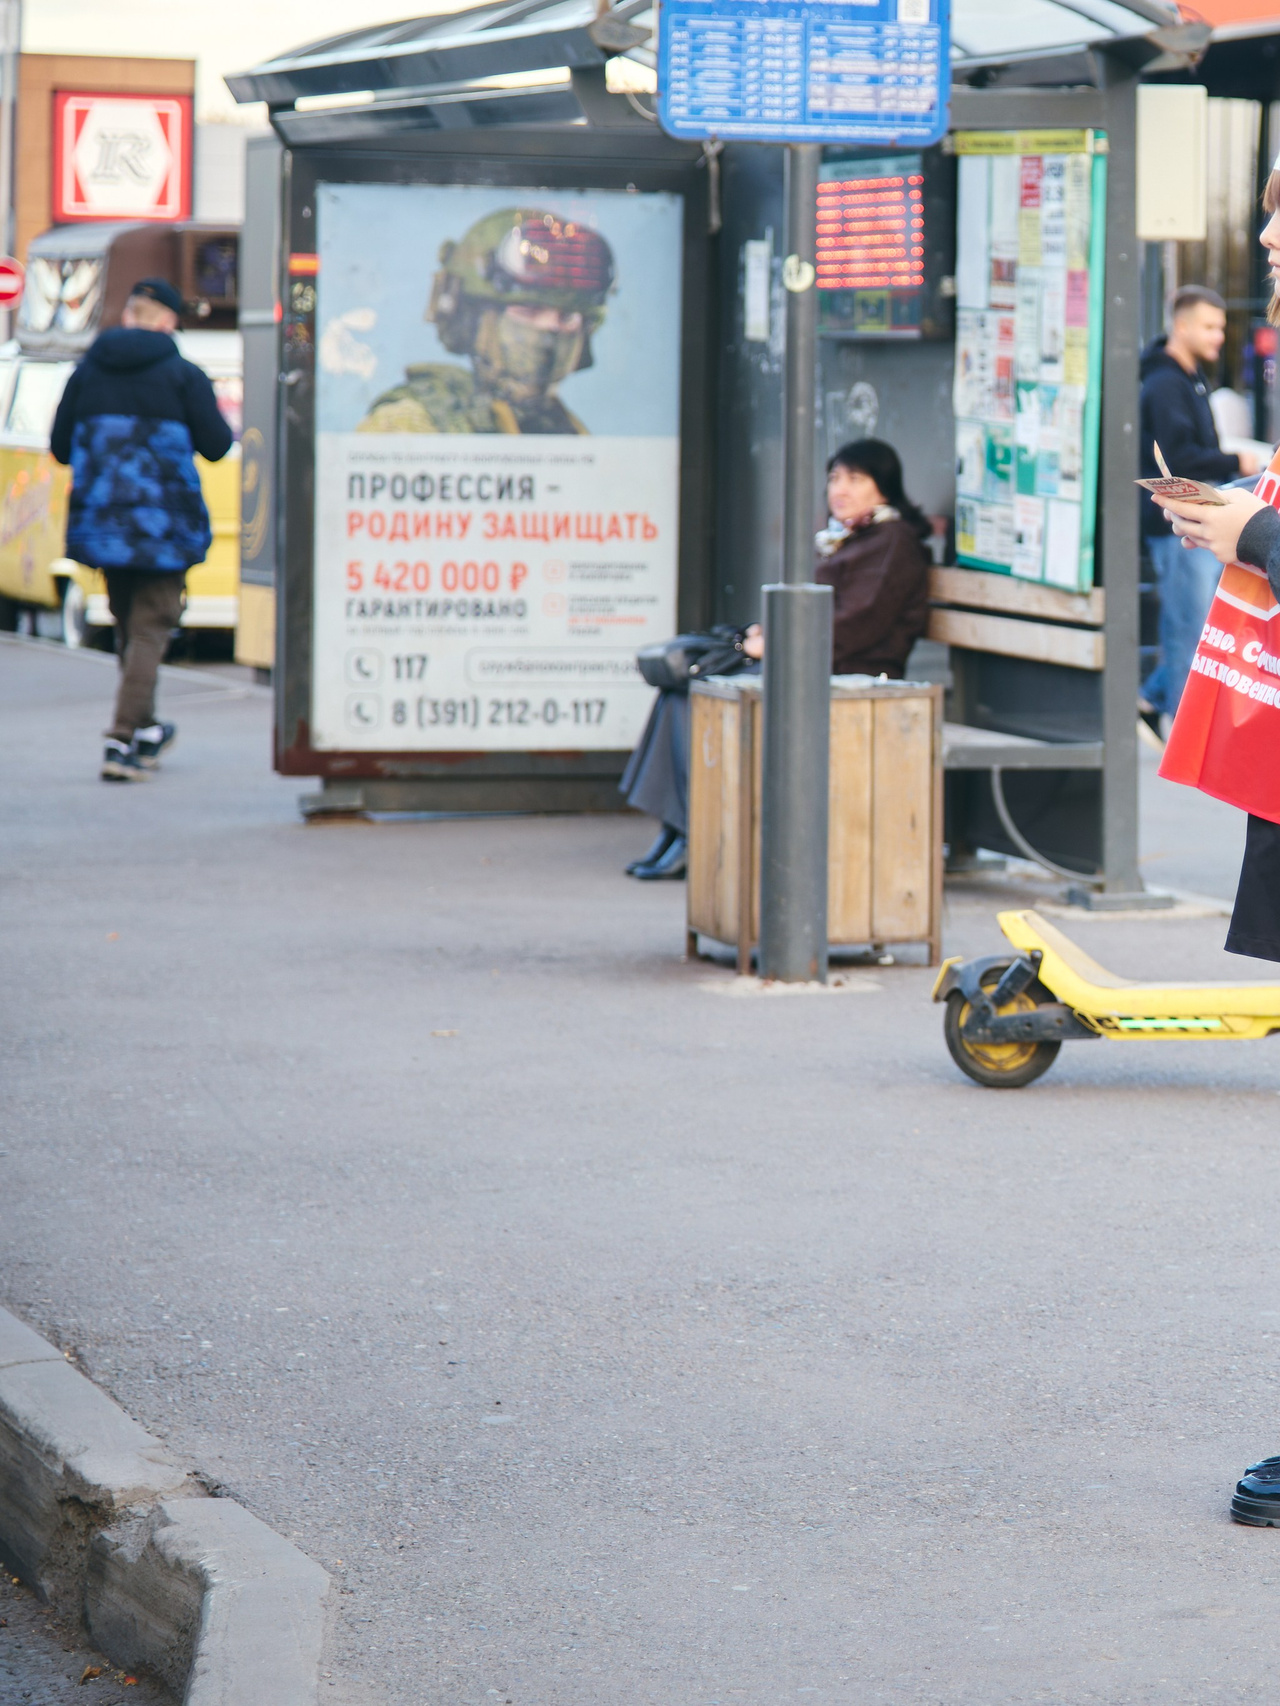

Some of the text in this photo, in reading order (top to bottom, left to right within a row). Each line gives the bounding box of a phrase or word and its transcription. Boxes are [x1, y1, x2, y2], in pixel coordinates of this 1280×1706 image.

[348, 473, 535, 502] ПРОФЕССИЯ
[346, 511, 659, 544] РОДИНУ ЗАЩИЩАТЬ
[346, 561, 364, 592] 5
[373, 561, 430, 592] 420
[440, 561, 500, 592] 000
[345, 600, 528, 619] ГАРАНТИРОВАНО
[391, 655, 429, 680] 117
[391, 698, 607, 729] 8 (391) 212-0-117
